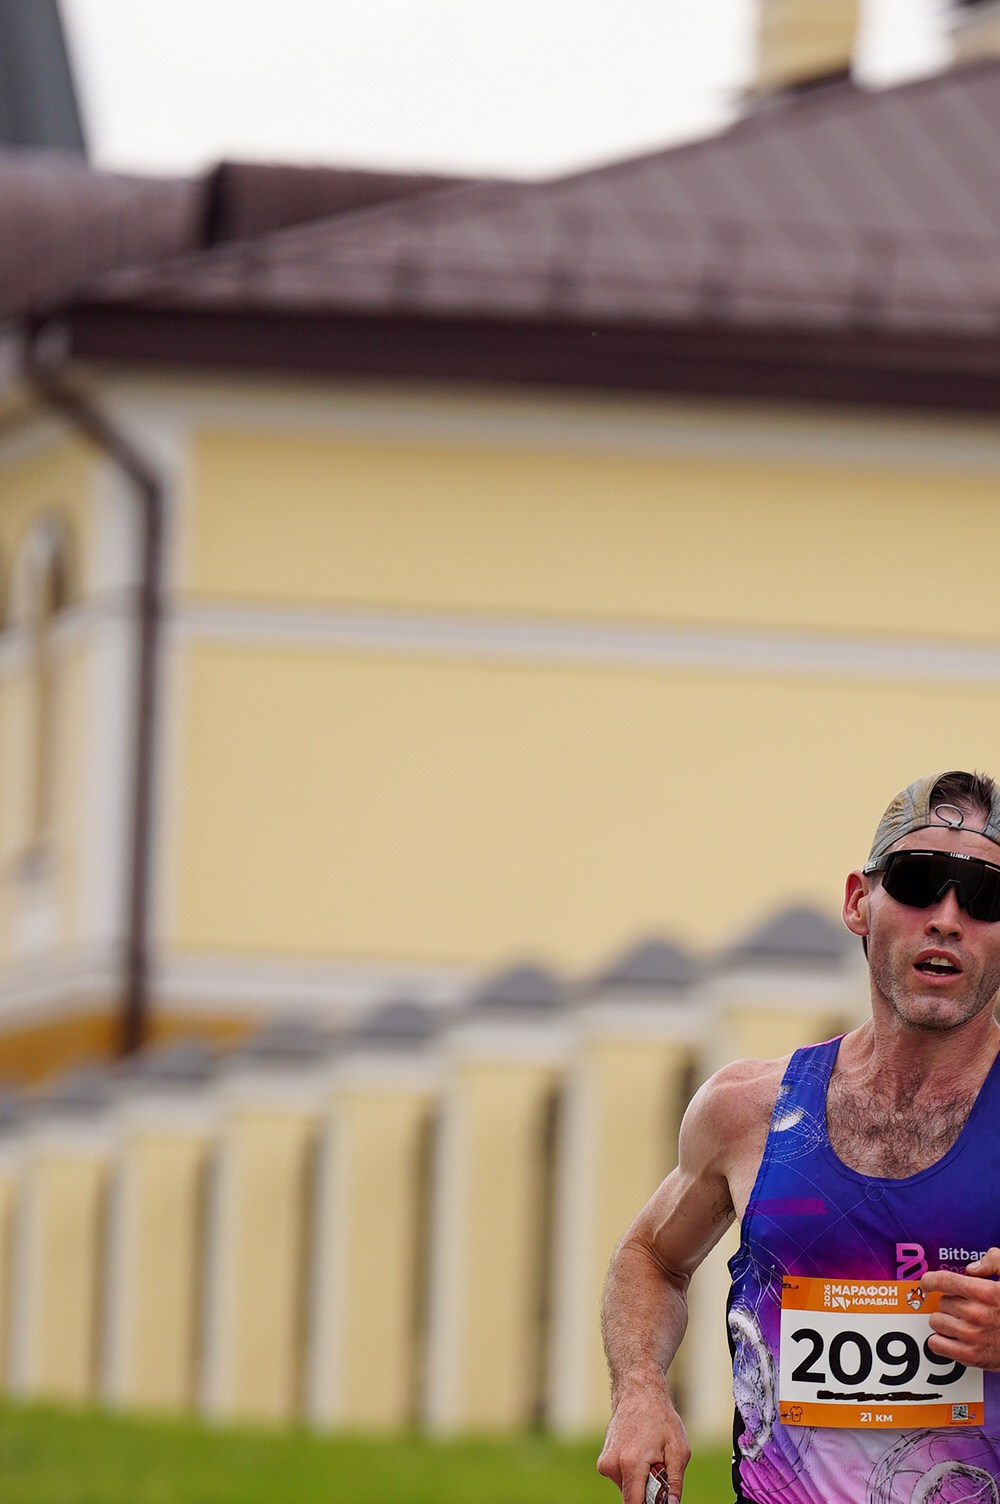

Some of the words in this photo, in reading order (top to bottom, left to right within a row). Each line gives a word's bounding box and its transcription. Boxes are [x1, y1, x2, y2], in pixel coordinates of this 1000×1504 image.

[823, 1284, 831, 1307] 2026
[831, 1284, 898, 1297] МАРАФОН
[852, 1297, 898, 1306] КАРАБАШ
[860, 1412, 872, 1423] 21
